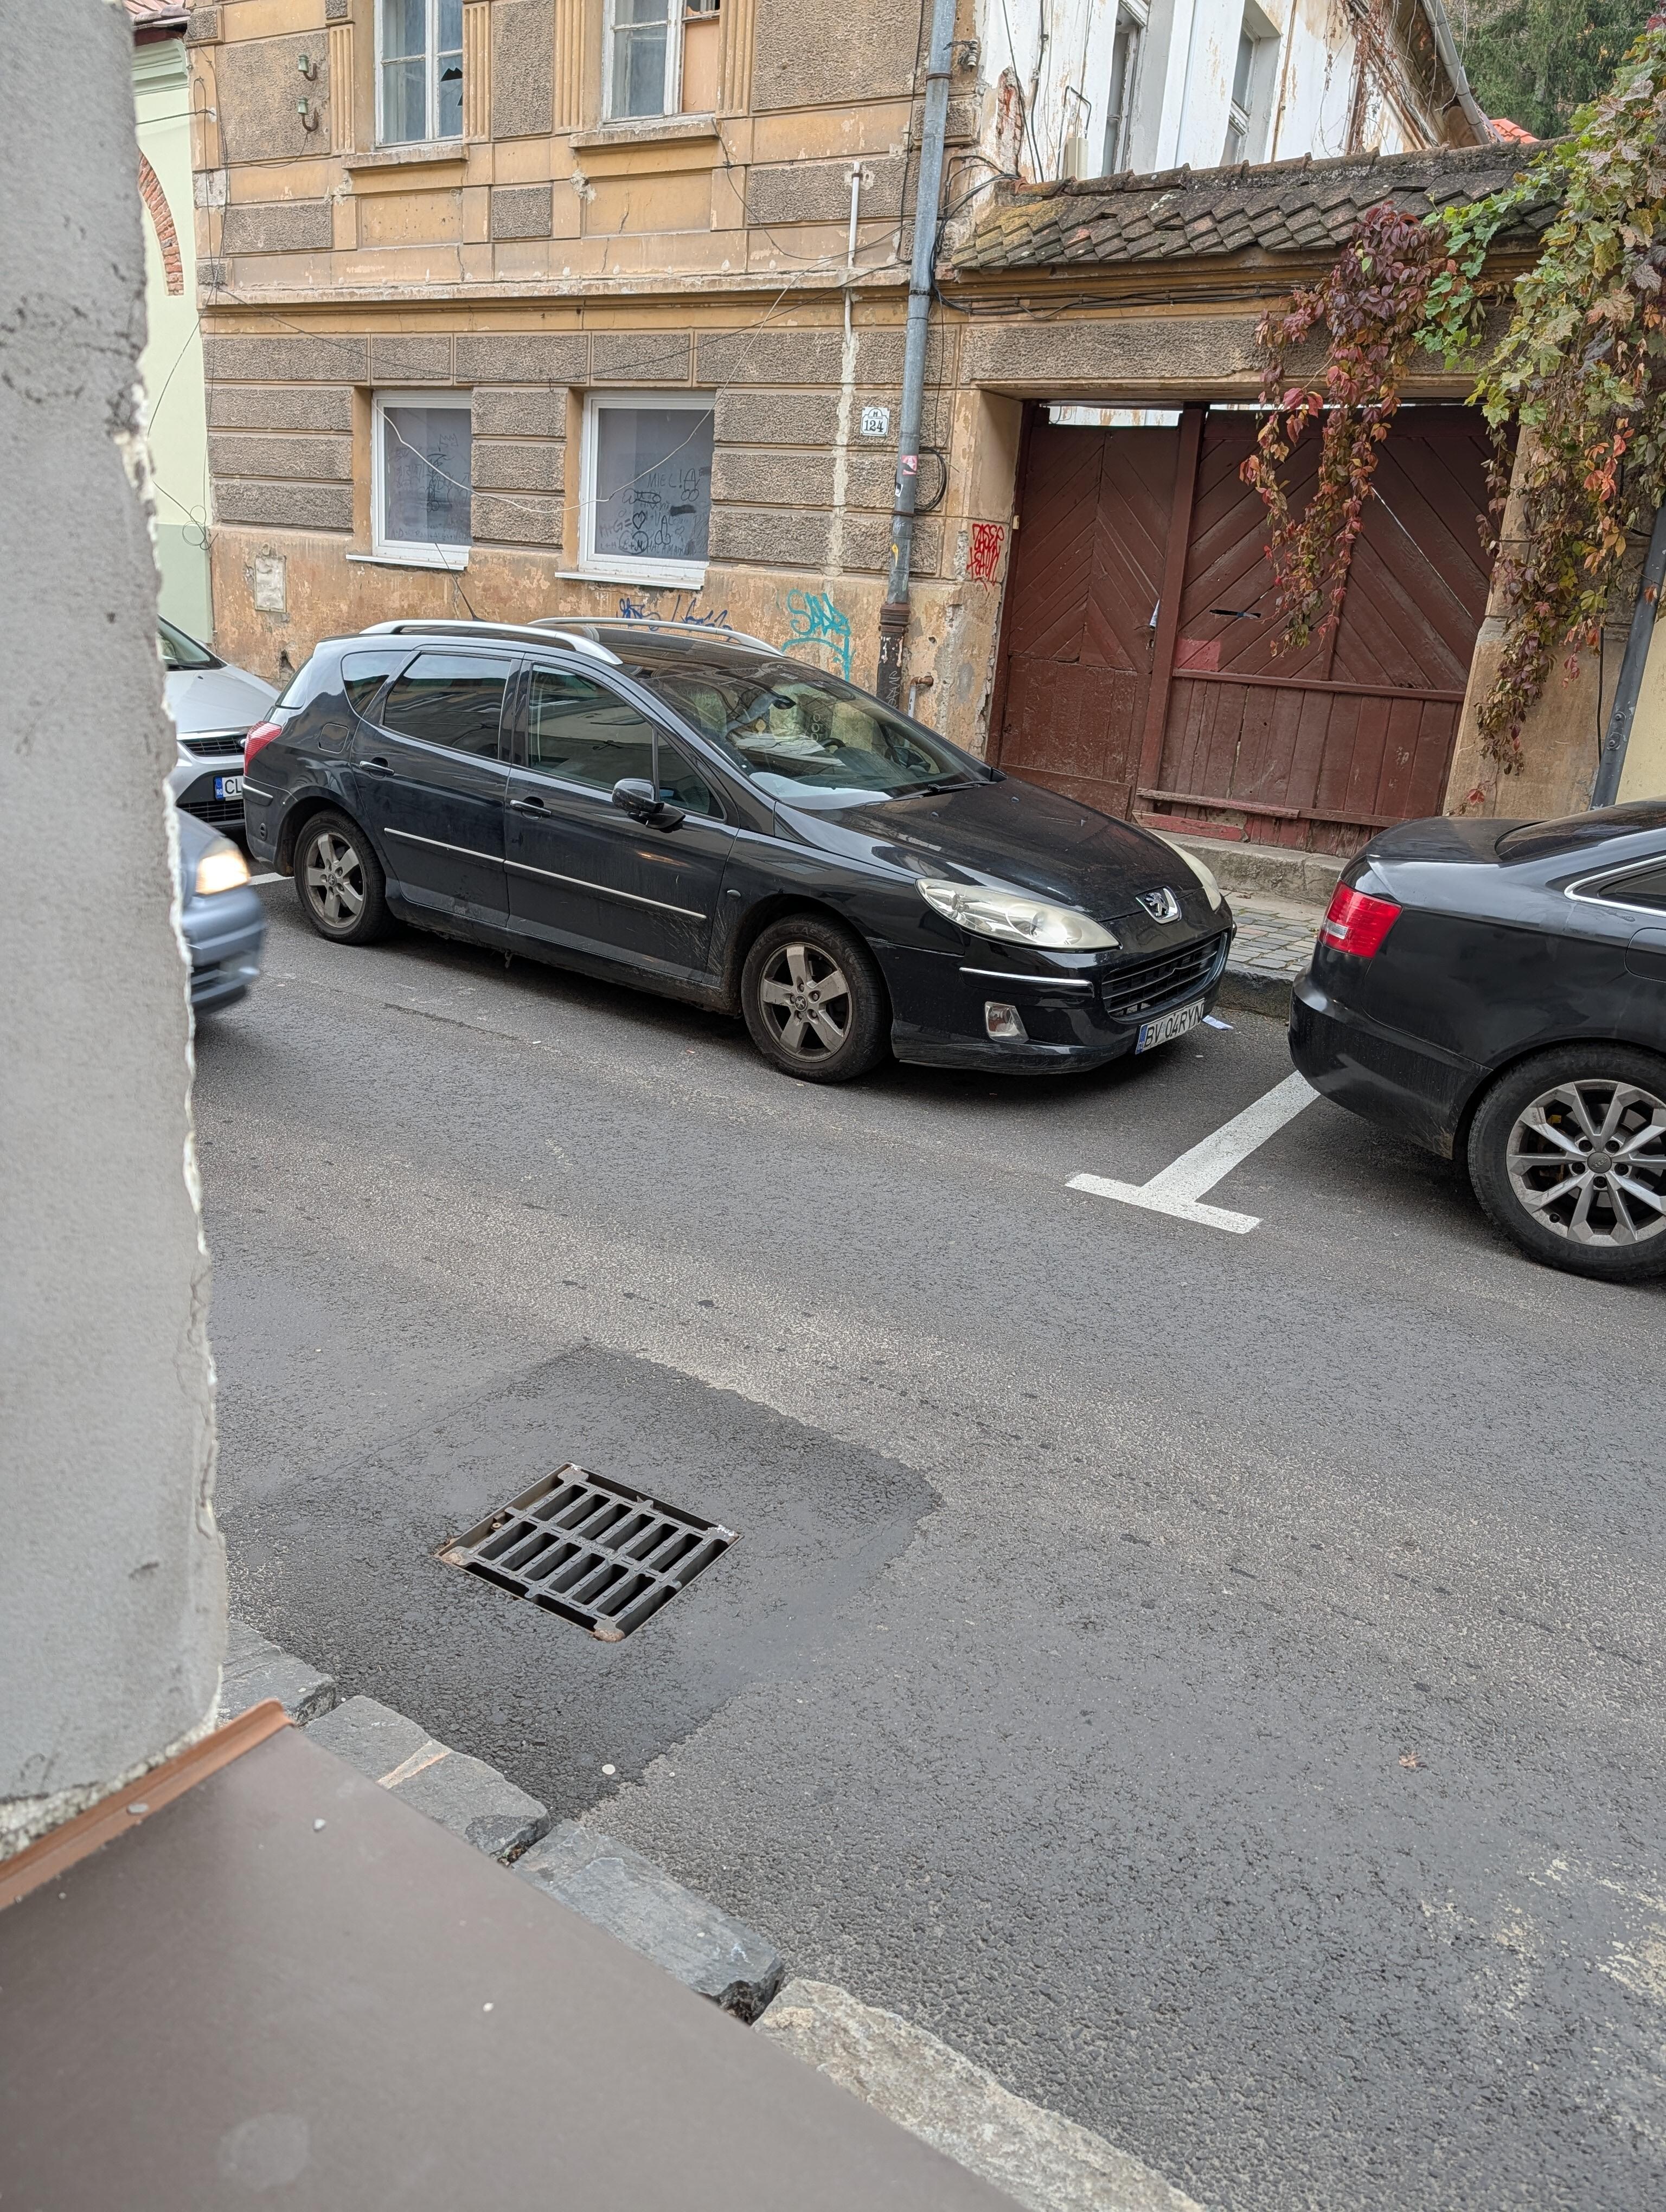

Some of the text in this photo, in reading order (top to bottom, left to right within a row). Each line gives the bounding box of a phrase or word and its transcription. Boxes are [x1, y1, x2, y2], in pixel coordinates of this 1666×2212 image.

[863, 420, 884, 433] 124
[225, 778, 242, 794] CL
[1144, 1021, 1163, 1048] BV
